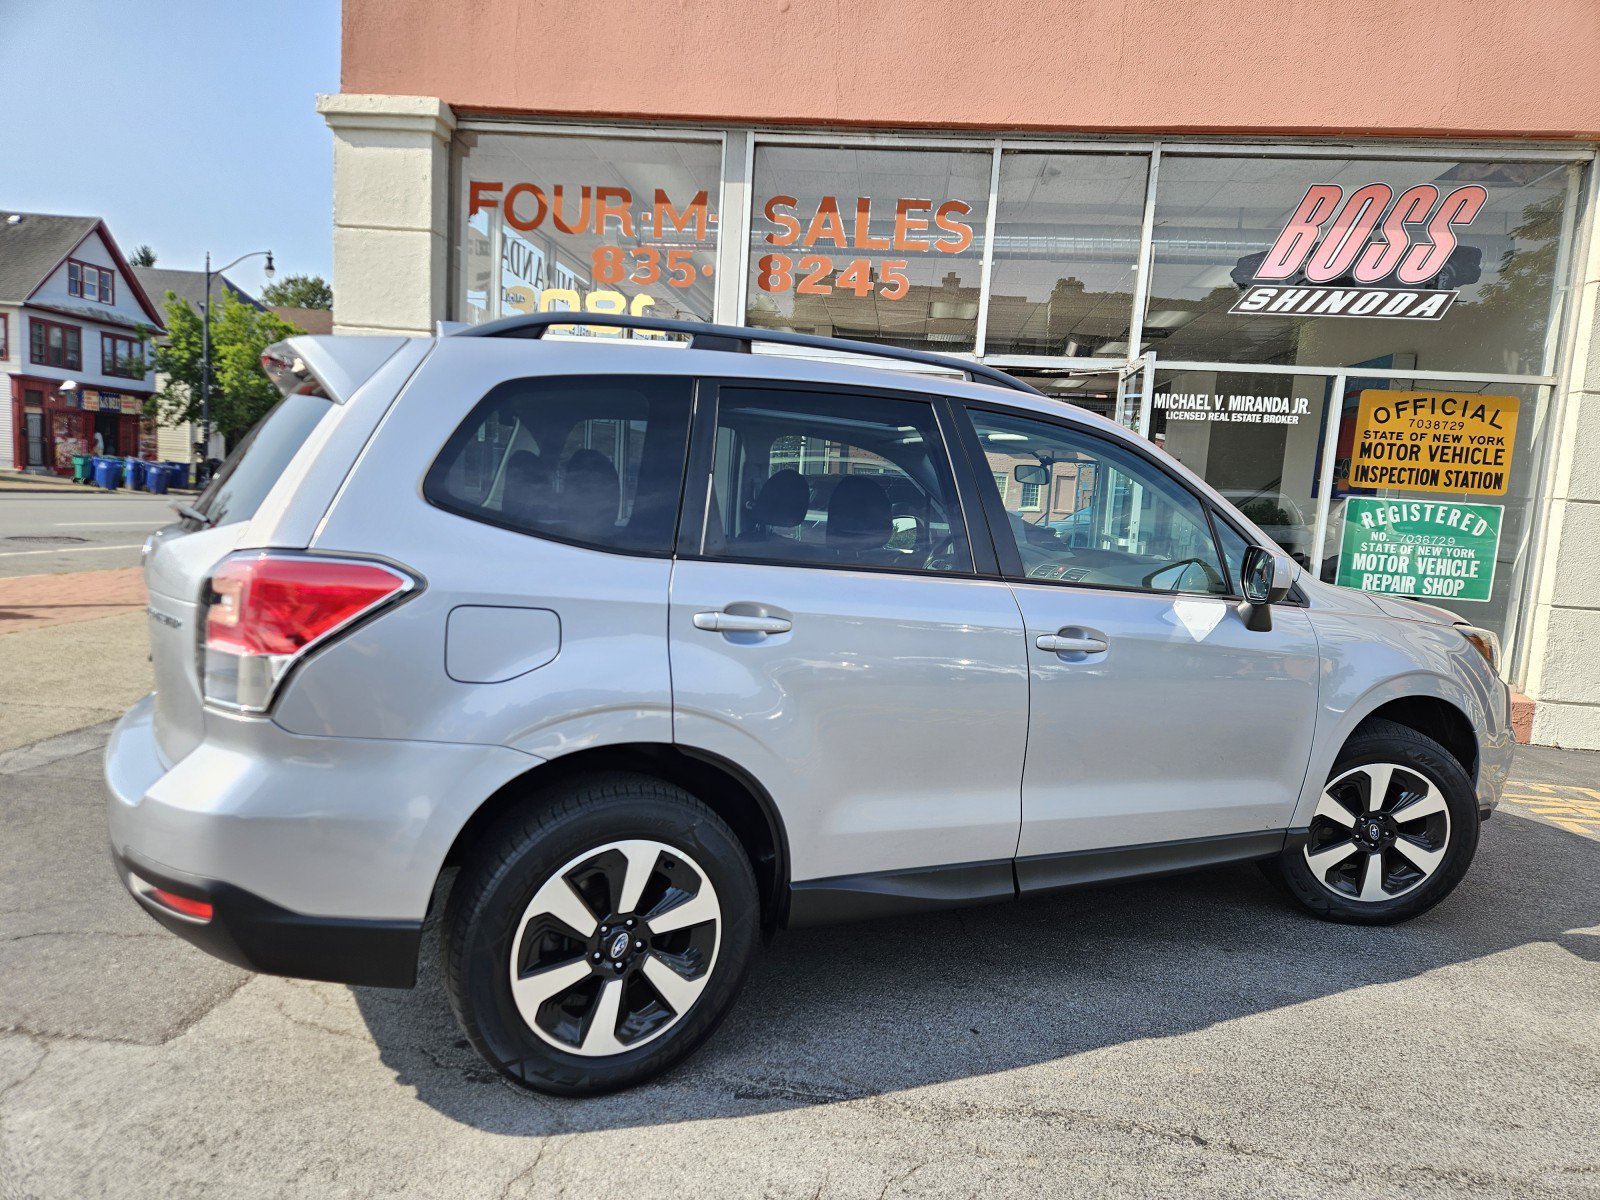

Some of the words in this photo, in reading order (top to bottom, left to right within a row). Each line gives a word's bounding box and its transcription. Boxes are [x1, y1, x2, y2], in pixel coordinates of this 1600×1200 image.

[763, 194, 974, 254] SALES
[1253, 182, 1488, 284] BOSS
[757, 253, 910, 300] 8245
[1239, 287, 1450, 318] SHINODA
[1154, 393, 1211, 411] MICHAEL
[1214, 394, 1225, 411] V.
[1228, 395, 1290, 413] MIRANDA
[1291, 398, 1311, 415] JR.
[1373, 397, 1503, 430] OFFICIAL
[1166, 411, 1207, 421] LICENSED
[1207, 412, 1230, 422] REAL
[1231, 413, 1262, 423] ESTATE
[1263, 414, 1299, 425] BROKER
[1408, 418, 1465, 431] 7038729
[1363, 429, 1404, 441] STATE
[1409, 432, 1428, 442] OF
[1432, 433, 1463, 444] NEW
[1468, 435, 1505, 446] YORK
[1359, 441, 1421, 462] MOTOR
[1428, 445, 1506, 466] VEHICLE
[1354, 464, 1440, 487] INSPECTION
[1443, 469, 1504, 490] STATION
[1360, 503, 1488, 537] REGISTERED
[1360, 542, 1397, 553] STATE
[1400, 545, 1414, 555] OF
[1417, 545, 1443, 557] NEW
[1445, 547, 1476, 559] YORK
[1370, 531, 1390, 542] NO.
[1399, 534, 1456, 546] 7038729
[1352, 553, 1410, 574] MOTOR
[1416, 557, 1481, 578] VEHICLE
[1362, 573, 1416, 594] REPAIR
[1422, 577, 1465, 597] SHOP
